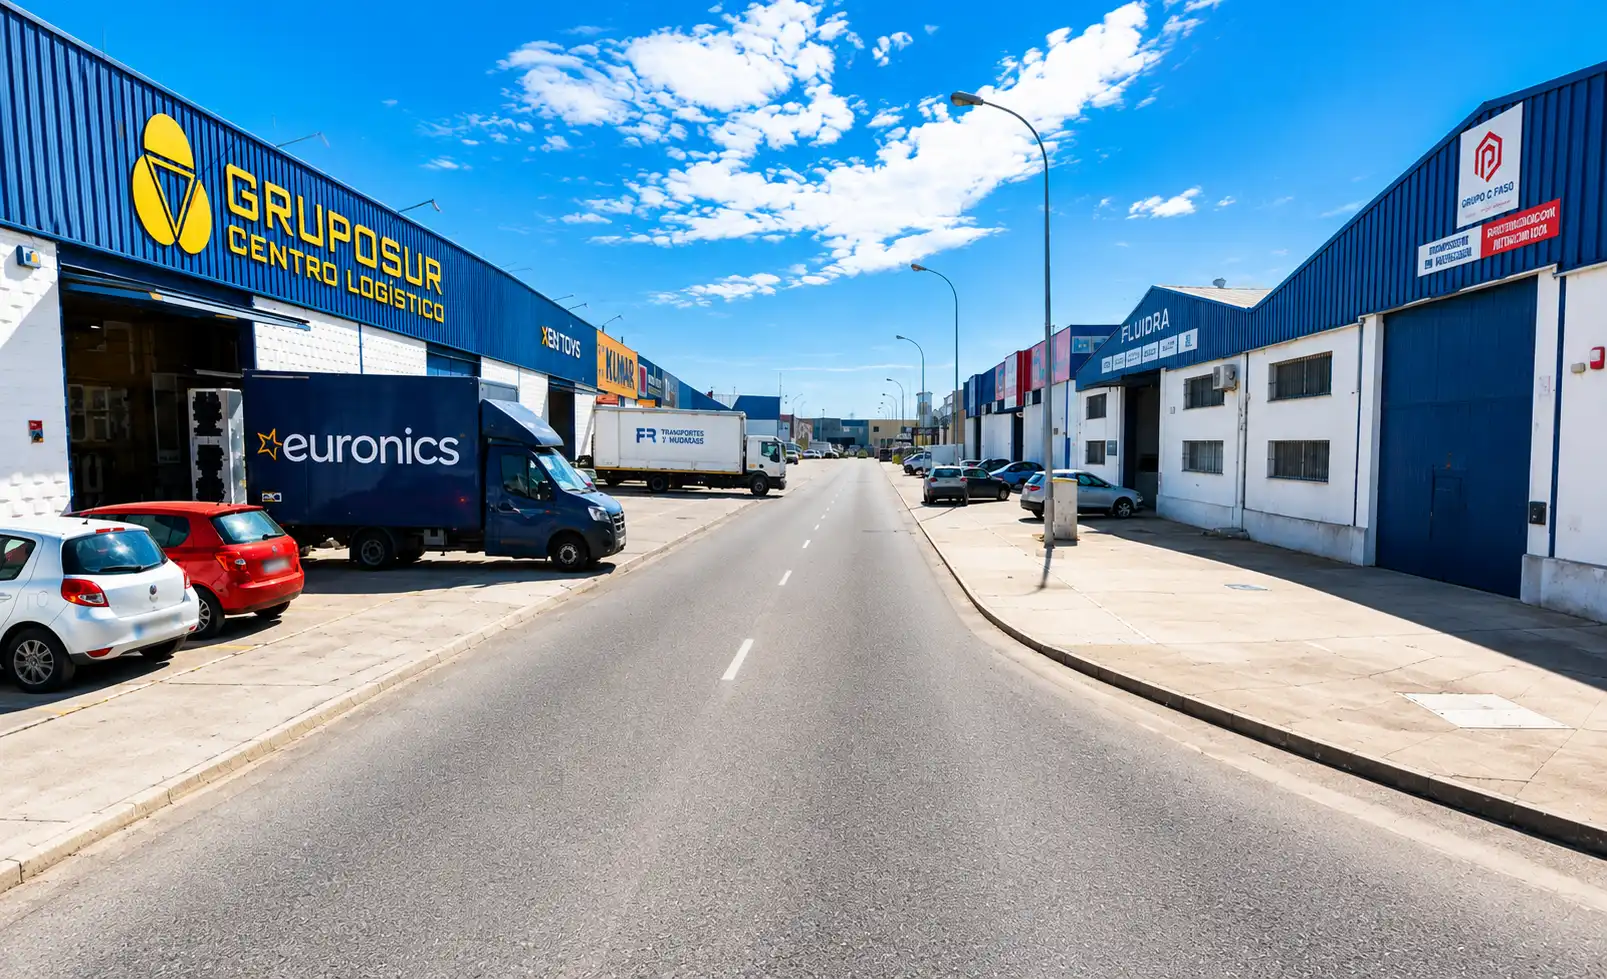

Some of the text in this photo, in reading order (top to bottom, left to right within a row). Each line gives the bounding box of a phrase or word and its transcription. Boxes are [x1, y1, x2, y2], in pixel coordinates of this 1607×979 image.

[226, 163, 443, 295] GRUPOSUR
[228, 224, 445, 323] CENTRO LOGÍSTICO
[1121, 308, 1170, 344] FLUIDRA
[559, 332, 581, 359] TOYS
[283, 427, 460, 466] euronics
[636, 427, 657, 444] FR
